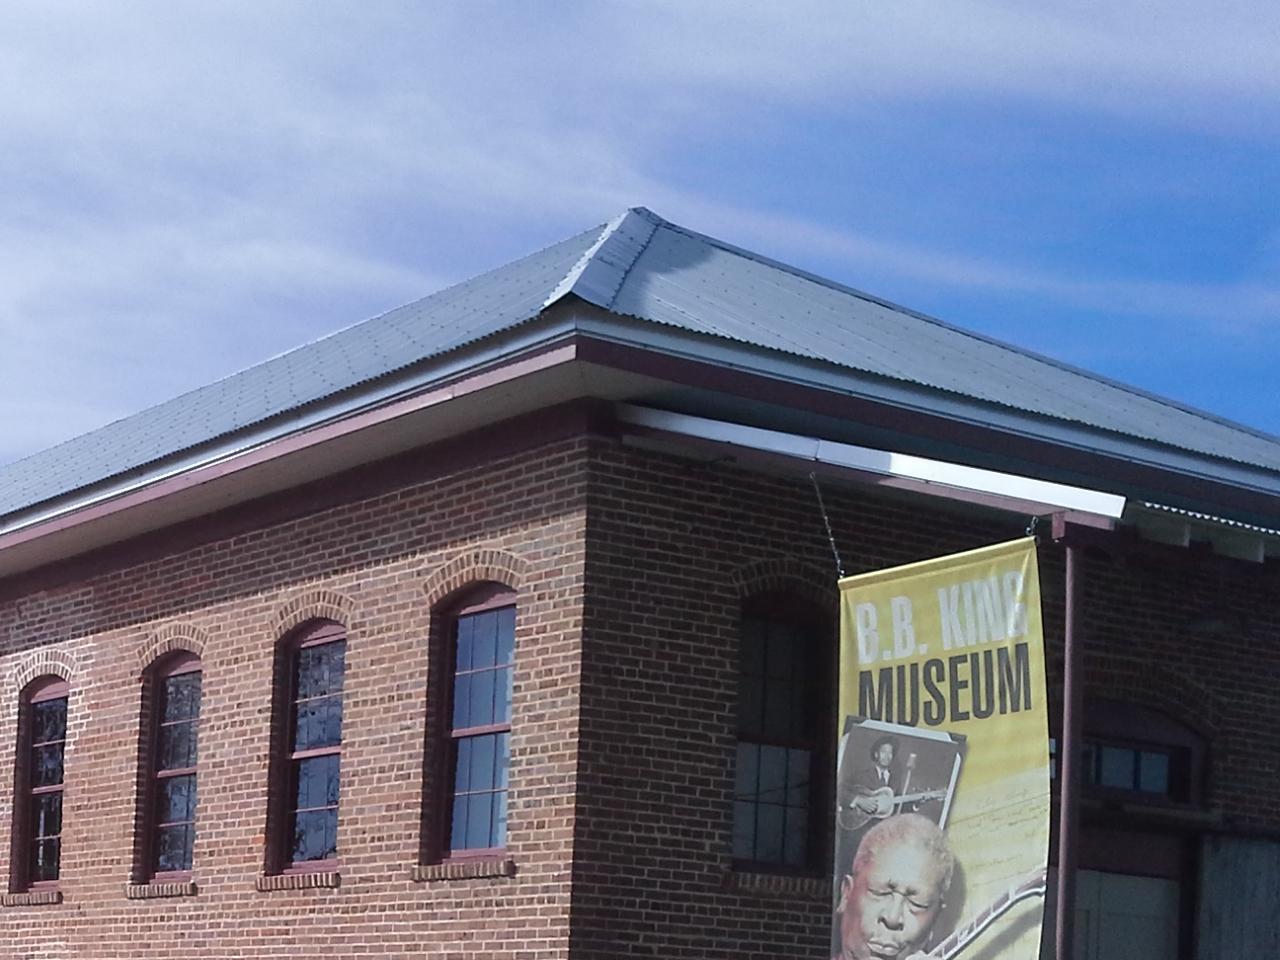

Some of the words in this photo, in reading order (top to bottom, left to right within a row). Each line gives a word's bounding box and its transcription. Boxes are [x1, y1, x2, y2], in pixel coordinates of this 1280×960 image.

[856, 596, 928, 665] B.B.
[938, 571, 1028, 650] KING
[859, 642, 1031, 727] MUSEUM
